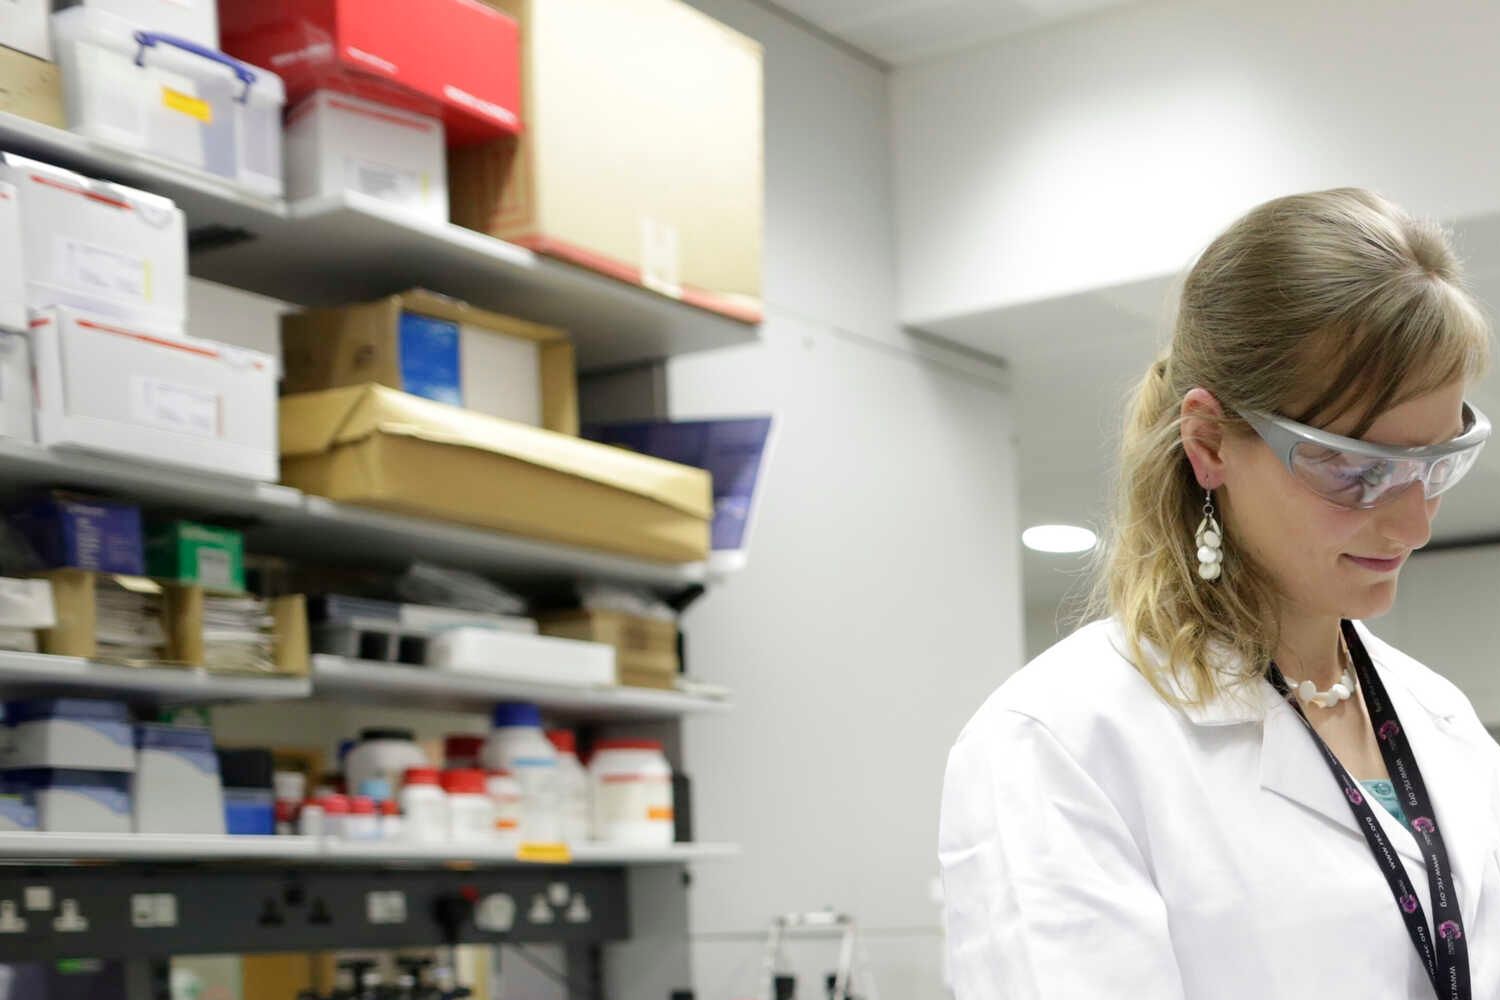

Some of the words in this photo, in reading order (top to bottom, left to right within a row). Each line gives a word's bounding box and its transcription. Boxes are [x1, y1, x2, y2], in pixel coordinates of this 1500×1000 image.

[1396, 757, 1418, 806] www.rsc.org
[1365, 816, 1396, 870] www.rsc.org
[1432, 854, 1448, 908] www.rsc.org
